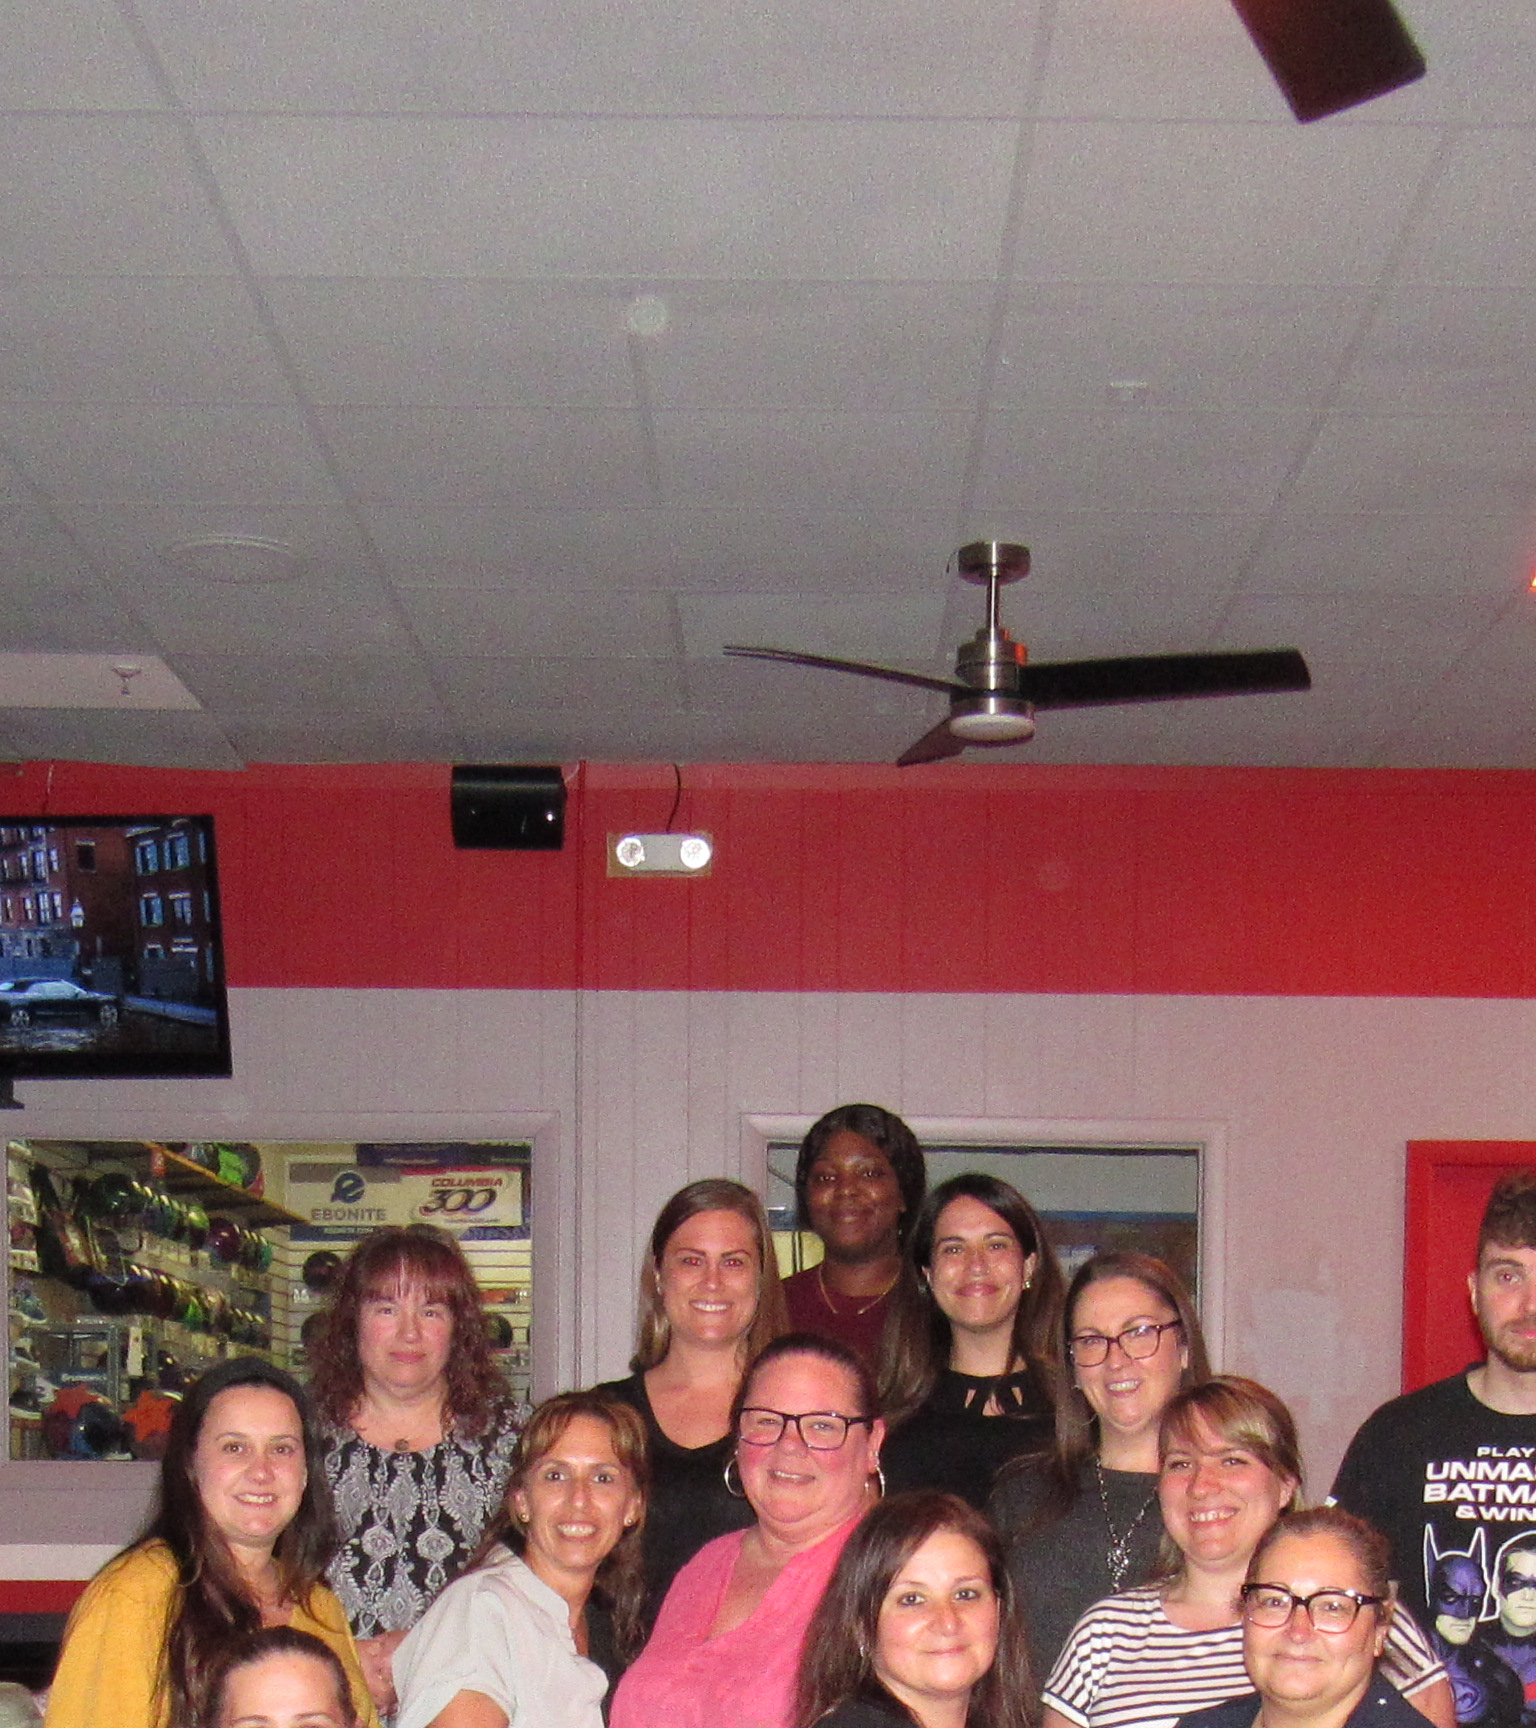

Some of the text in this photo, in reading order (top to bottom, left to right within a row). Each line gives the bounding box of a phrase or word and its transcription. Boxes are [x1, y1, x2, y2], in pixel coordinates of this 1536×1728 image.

[431, 1177, 503, 1188] COLUMBIA
[419, 1188, 497, 1217] 300
[310, 1207, 387, 1222] EBONITE
[1476, 1446, 1536, 1458] PLAY
[1455, 1505, 1477, 1520] &
